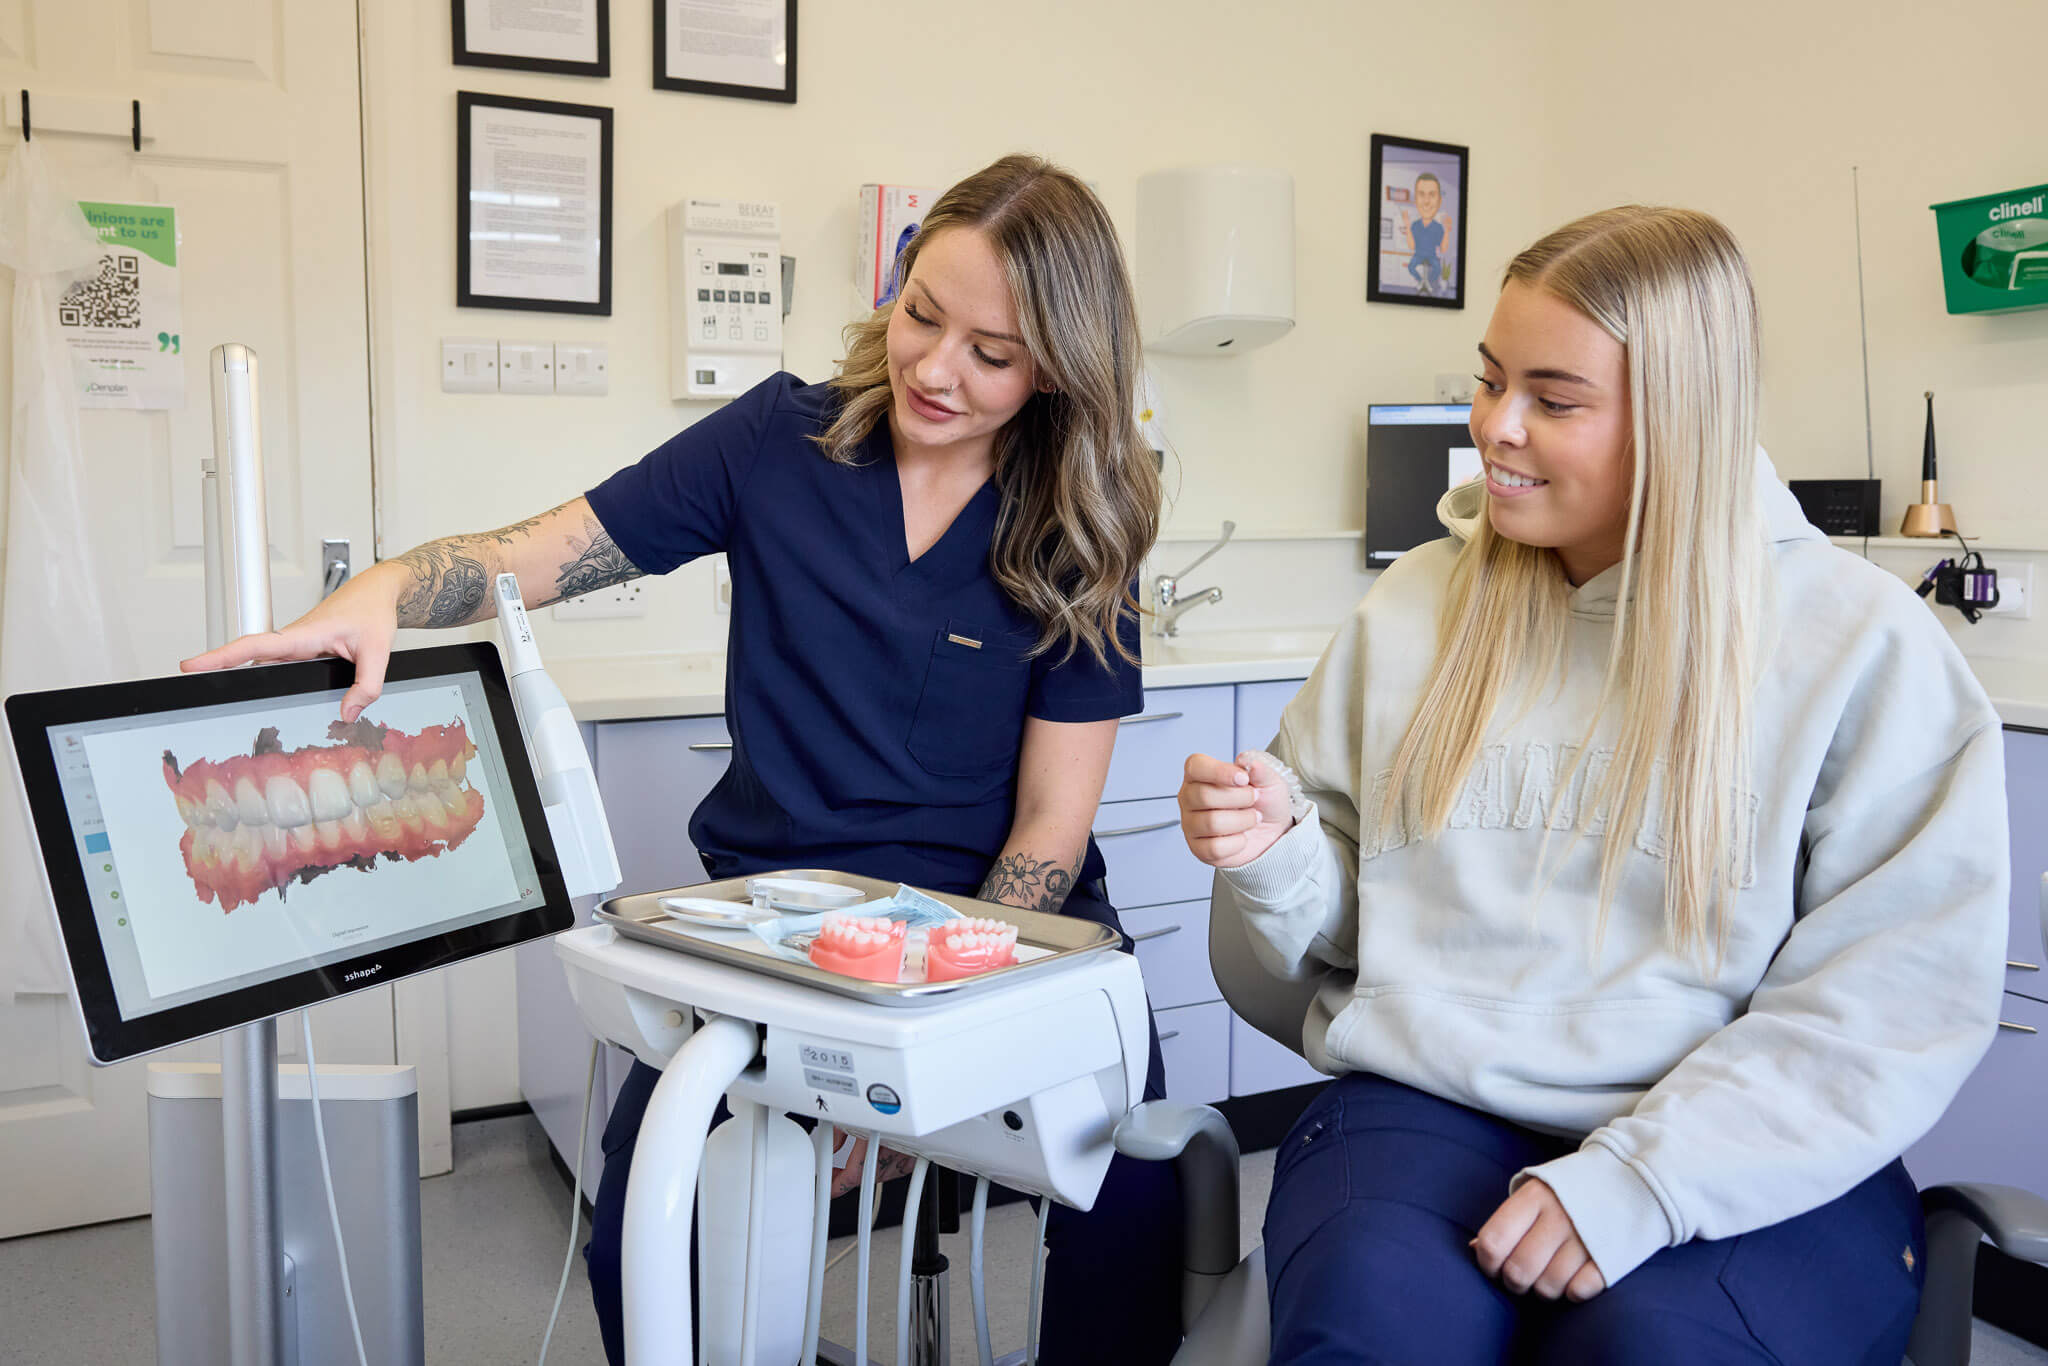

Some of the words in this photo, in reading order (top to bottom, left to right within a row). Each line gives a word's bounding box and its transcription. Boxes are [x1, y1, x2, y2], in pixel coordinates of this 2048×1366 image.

[908, 194, 918, 207] M
[1989, 196, 2043, 221] clinell
[87, 210, 137, 225] inions
[140, 216, 165, 227] are
[121, 226, 137, 238] to
[141, 229, 160, 239] us
[90, 382, 128, 392] Denplan
[344, 967, 376, 982] 3shape
[811, 1050, 849, 1066] 2015
